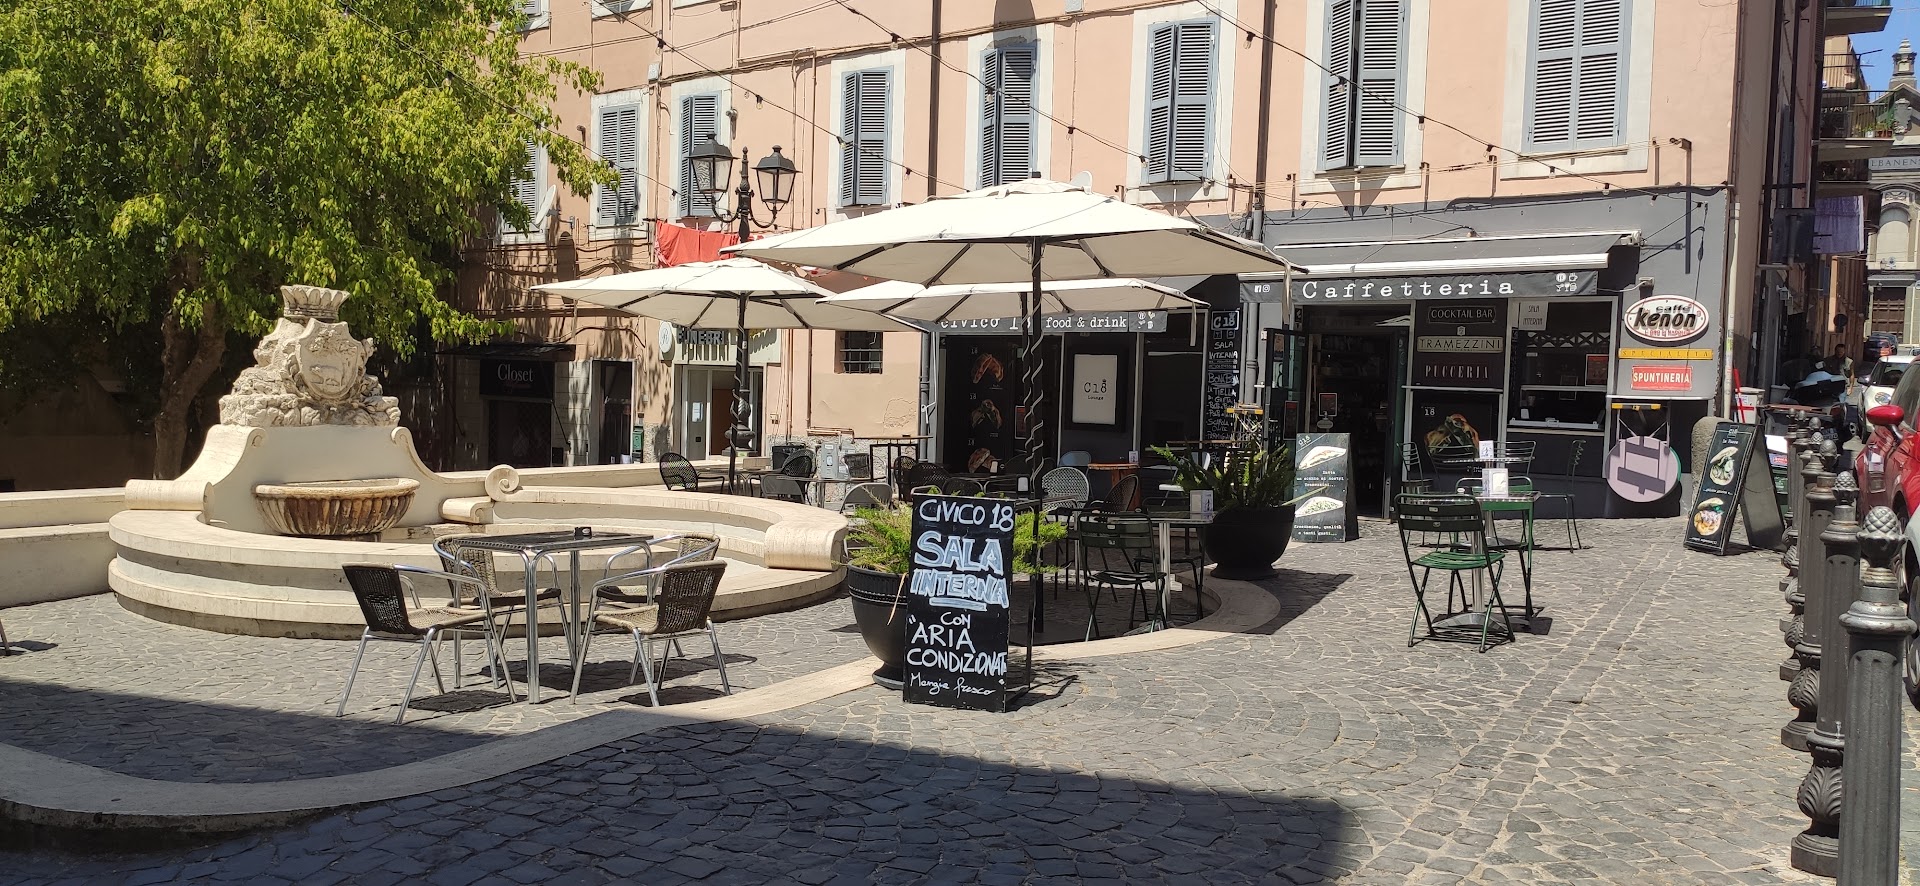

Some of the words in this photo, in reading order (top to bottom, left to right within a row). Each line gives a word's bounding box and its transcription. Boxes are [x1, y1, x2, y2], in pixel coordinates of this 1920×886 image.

[1871, 159, 1920, 167] LBANEN
[1302, 280, 1514, 299] Caffetteria
[1431, 309, 1473, 319] COCKTAIL
[1476, 309, 1493, 319] BAR
[1633, 307, 1697, 329] kenon
[1045, 316, 1072, 328] food
[1077, 316, 1085, 328] &
[1090, 315, 1127, 328] drink
[1214, 341, 1234, 350] SALA
[1420, 339, 1500, 349] TRAMEZZINI
[497, 363, 533, 382] Closet
[1425, 364, 1488, 379] PUCCERIA
[1633, 372, 1690, 383] SPUNTINERIA
[1084, 382, 1107, 393] C18
[1424, 408, 1435, 416] 18
[919, 499, 986, 525] CIVICO
[989, 503, 1014, 532] 18
[914, 530, 1004, 576] SALA
[910, 568, 1010, 609] INTERNA
[940, 611, 971, 629] CON
